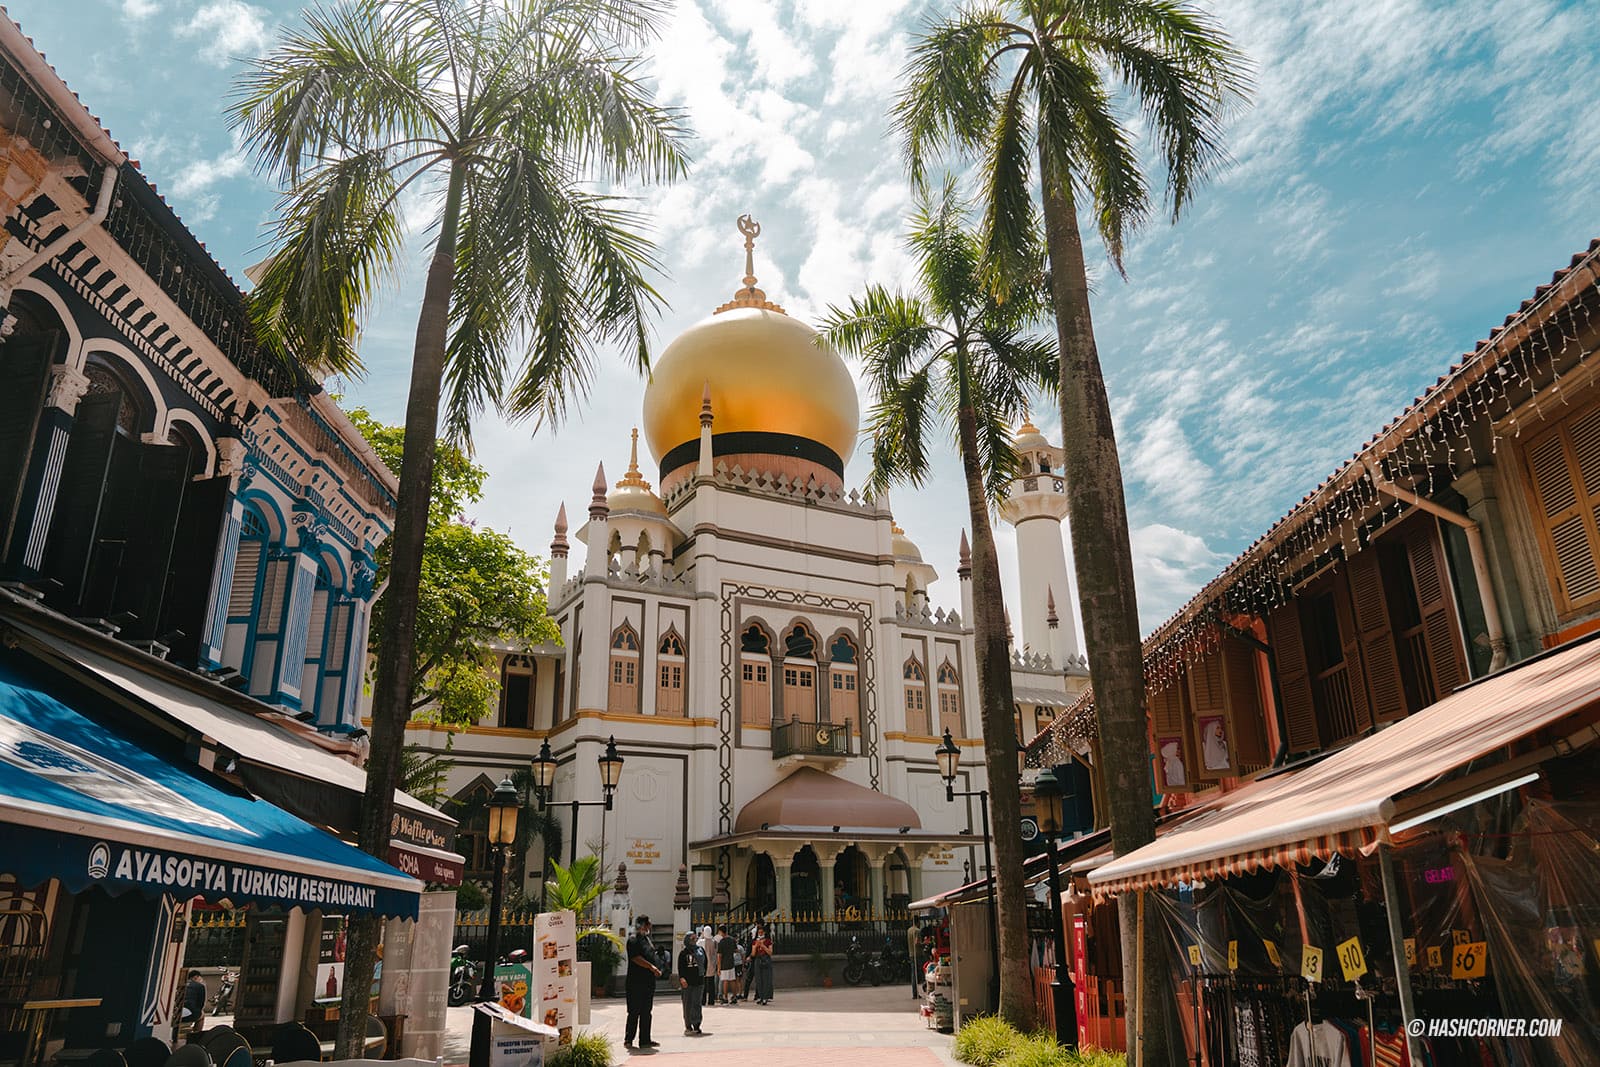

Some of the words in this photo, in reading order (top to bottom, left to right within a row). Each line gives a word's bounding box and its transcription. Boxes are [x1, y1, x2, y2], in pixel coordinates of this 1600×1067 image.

[400, 816, 426, 841] Waffle
[399, 853, 420, 875] SOHA
[115, 849, 226, 892] AYASOFYA
[232, 867, 298, 899] TURKISH
[300, 878, 376, 908] RESTAURANT
[1304, 955, 1318, 974] $3
[1343, 944, 1361, 971] $10
